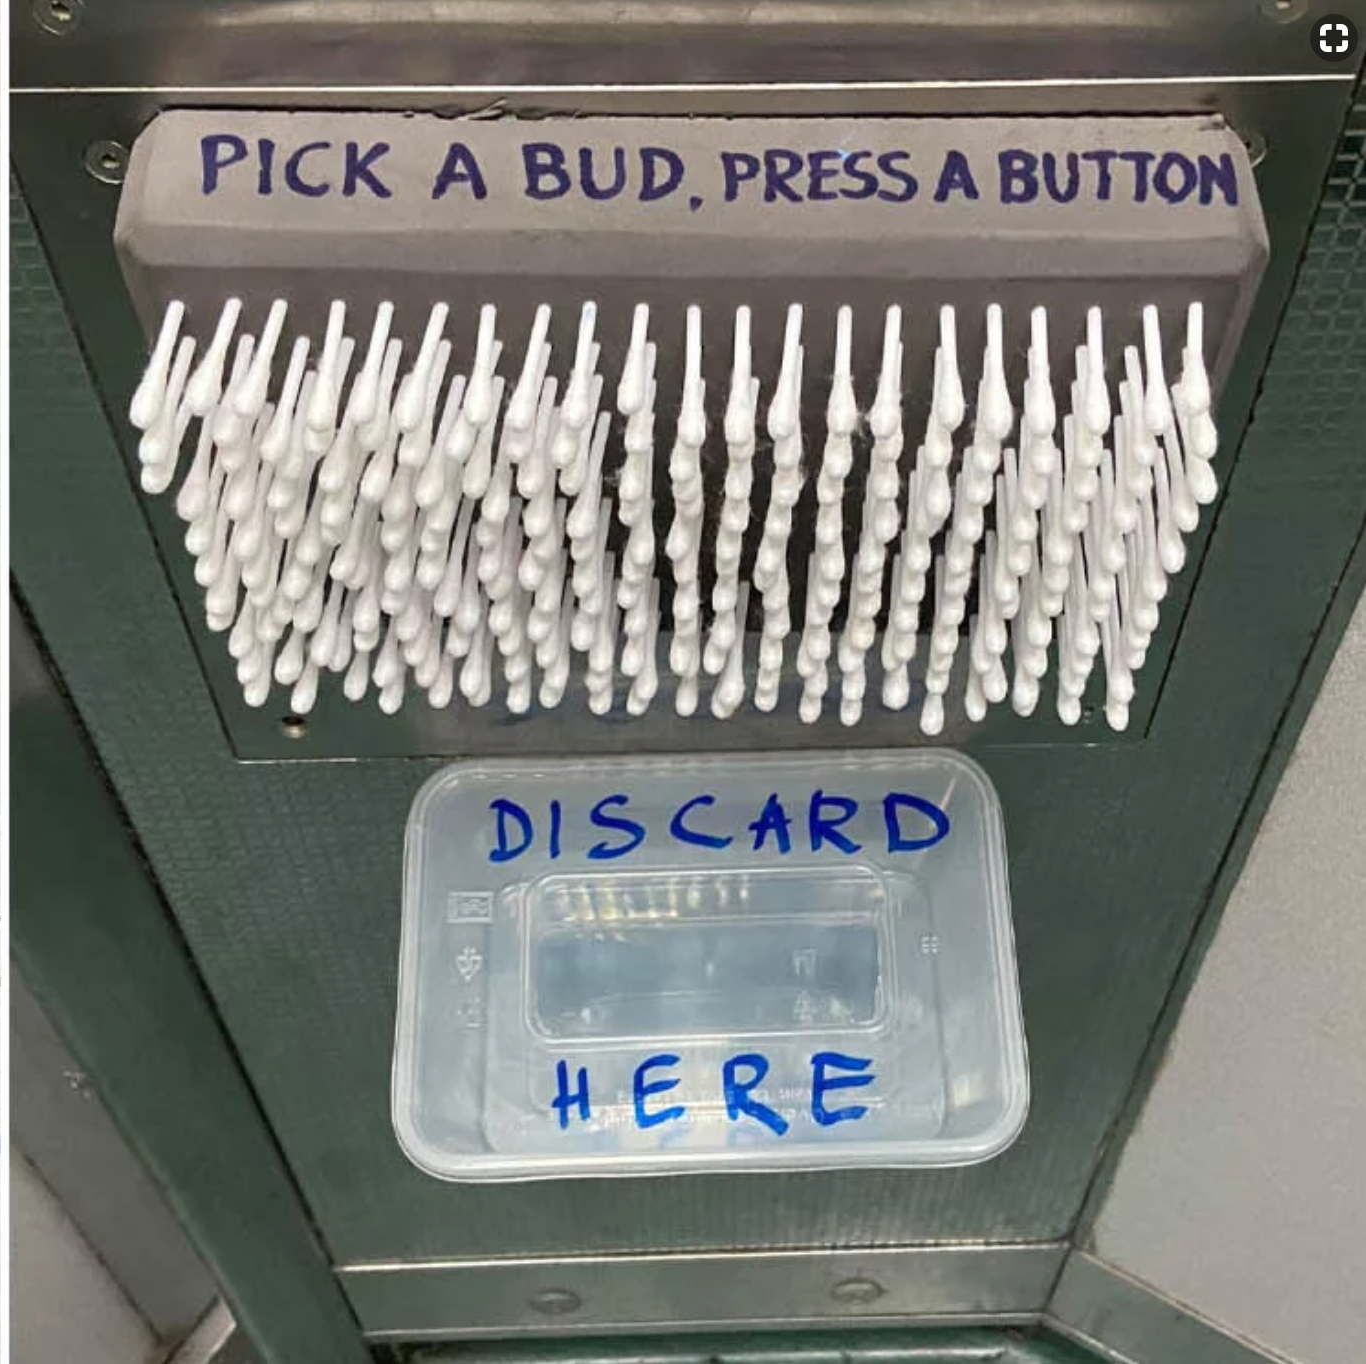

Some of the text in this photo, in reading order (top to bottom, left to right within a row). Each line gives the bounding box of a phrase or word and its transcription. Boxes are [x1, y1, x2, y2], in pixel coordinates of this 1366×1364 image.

[200, 133, 393, 199] PICK
[431, 142, 488, 201] A
[720, 149, 919, 202] PRESS
[933, 149, 979, 202] A
[997, 149, 1239, 206] BUTTON
[488, 790, 951, 863] DISCARD
[551, 1052, 876, 1137] HERE
